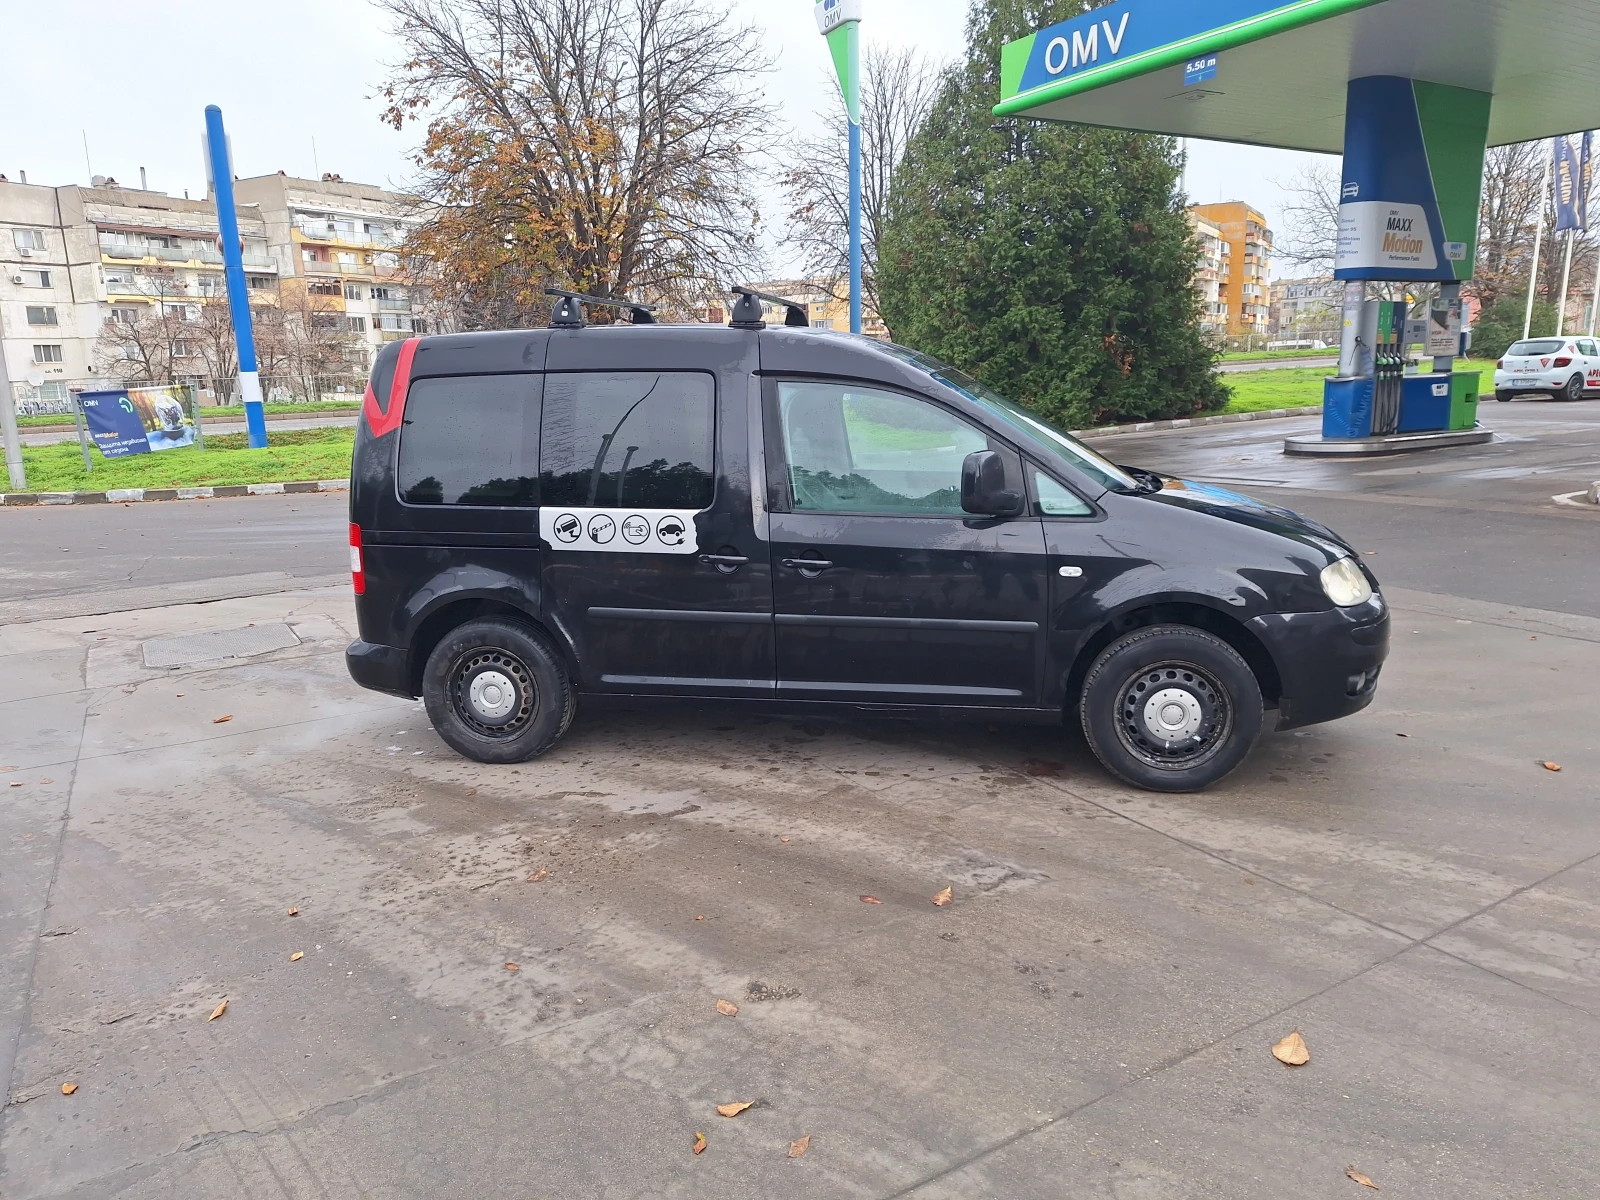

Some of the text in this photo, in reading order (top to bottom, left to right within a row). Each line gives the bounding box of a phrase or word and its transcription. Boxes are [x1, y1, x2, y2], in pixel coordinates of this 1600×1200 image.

[824, 7, 842, 28] OMV
[1044, 11, 1130, 75] OMV
[1186, 57, 1216, 73] 5.50 m
[1386, 217, 1414, 232] MAXX
[1382, 232, 1424, 254] Motion
[83, 399, 99, 407] OMV
